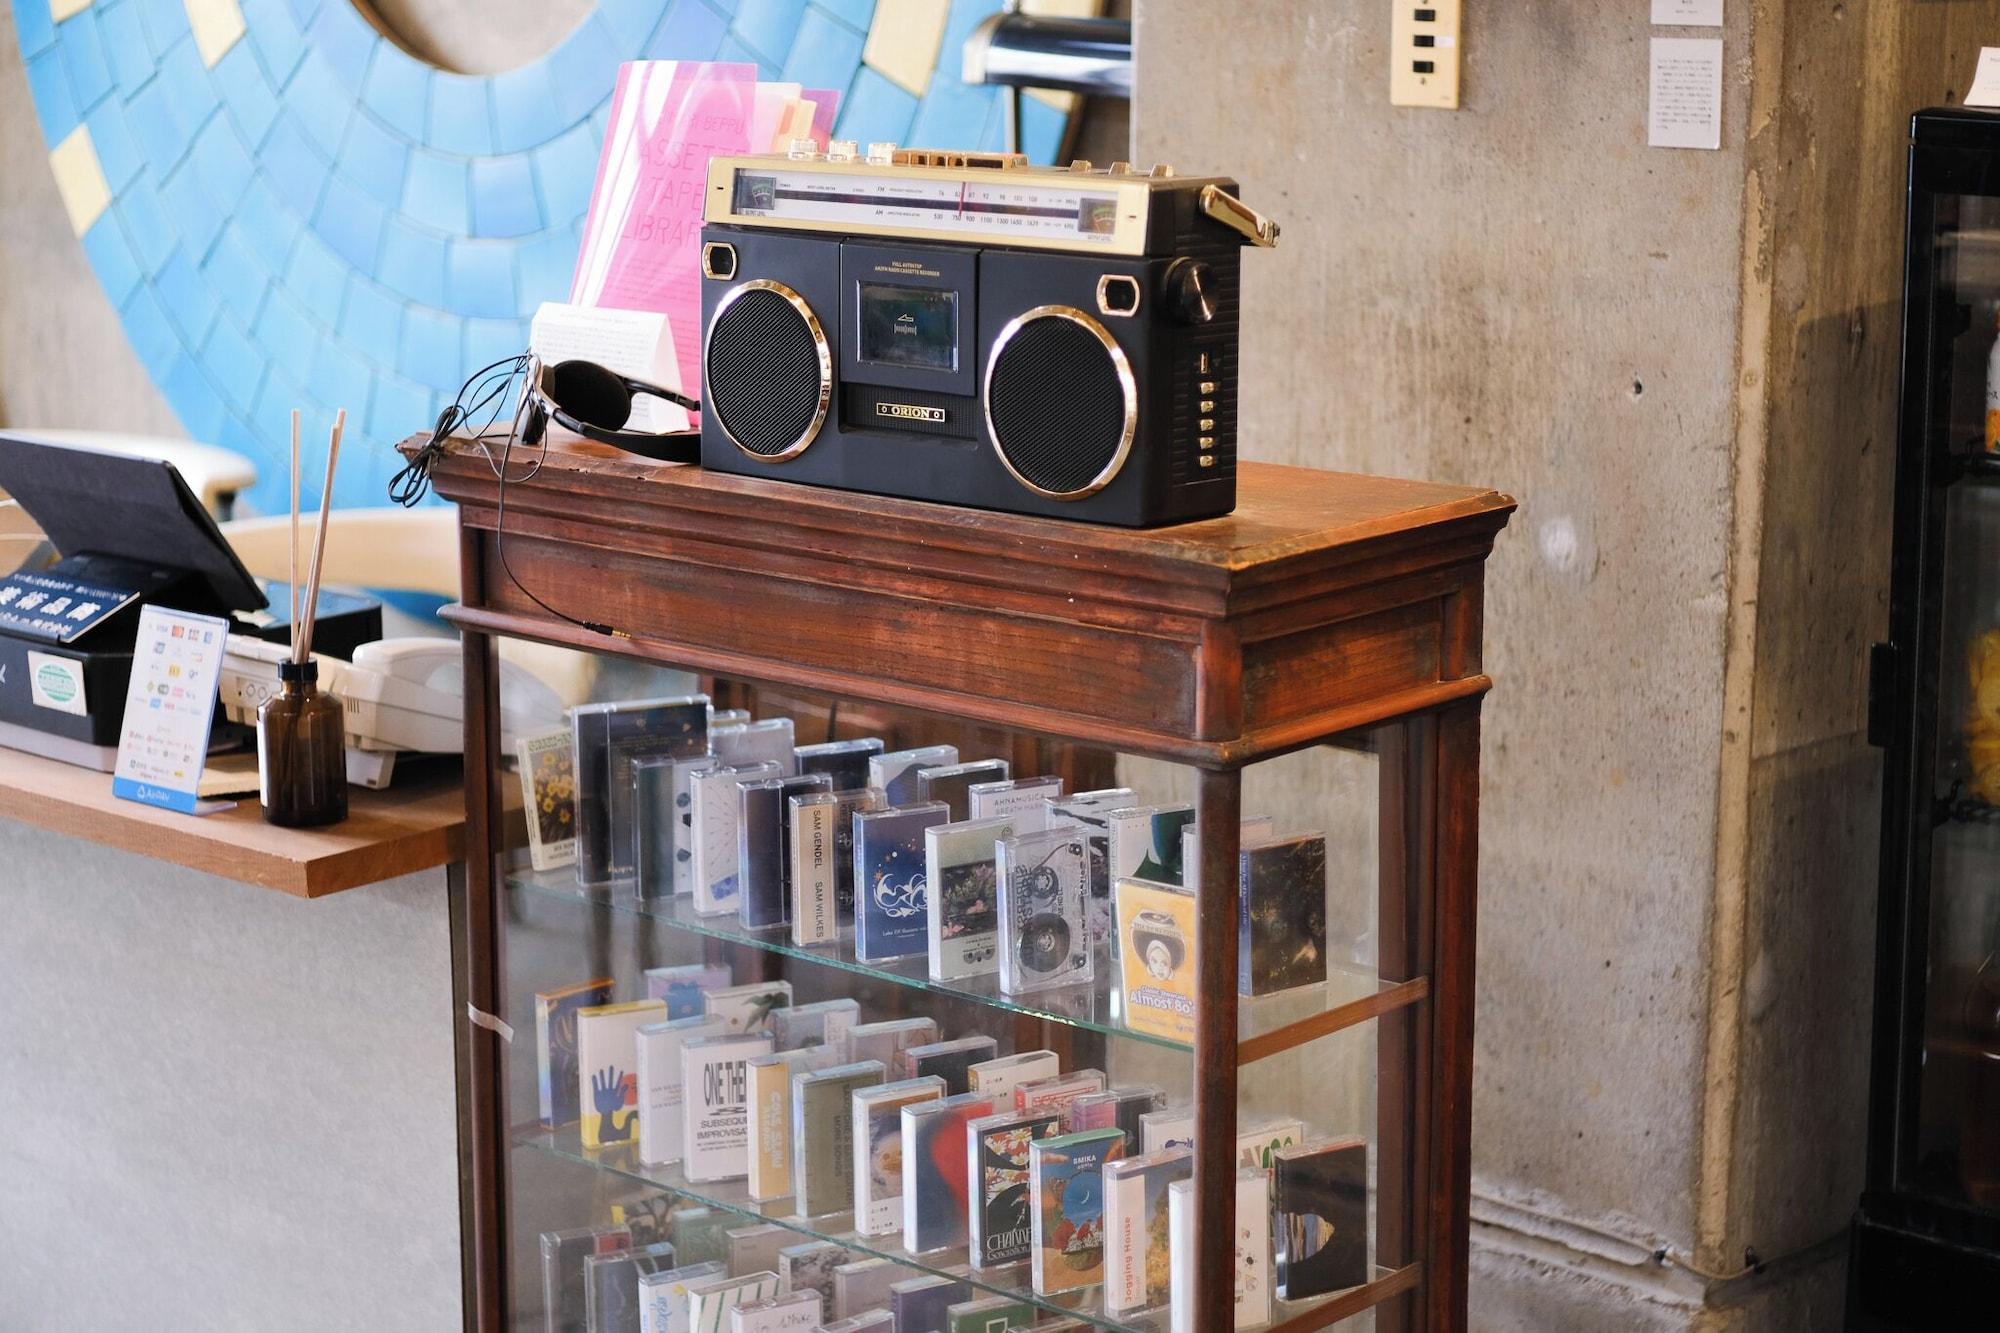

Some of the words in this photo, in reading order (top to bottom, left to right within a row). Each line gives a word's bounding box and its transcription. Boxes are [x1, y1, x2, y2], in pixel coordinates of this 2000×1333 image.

[891, 406, 930, 418] ORION
[813, 809, 822, 830] SAM
[813, 830, 823, 870] GENDEL
[814, 881, 823, 902] SAM
[815, 903, 825, 938] WILKES
[1130, 989, 1173, 1010] Almost
[703, 1061, 724, 1107] ONE
[696, 1126, 748, 1140] IMPROVISA
[1122, 1216, 1132, 1254] House
[1122, 1256, 1133, 1304] Jogging
